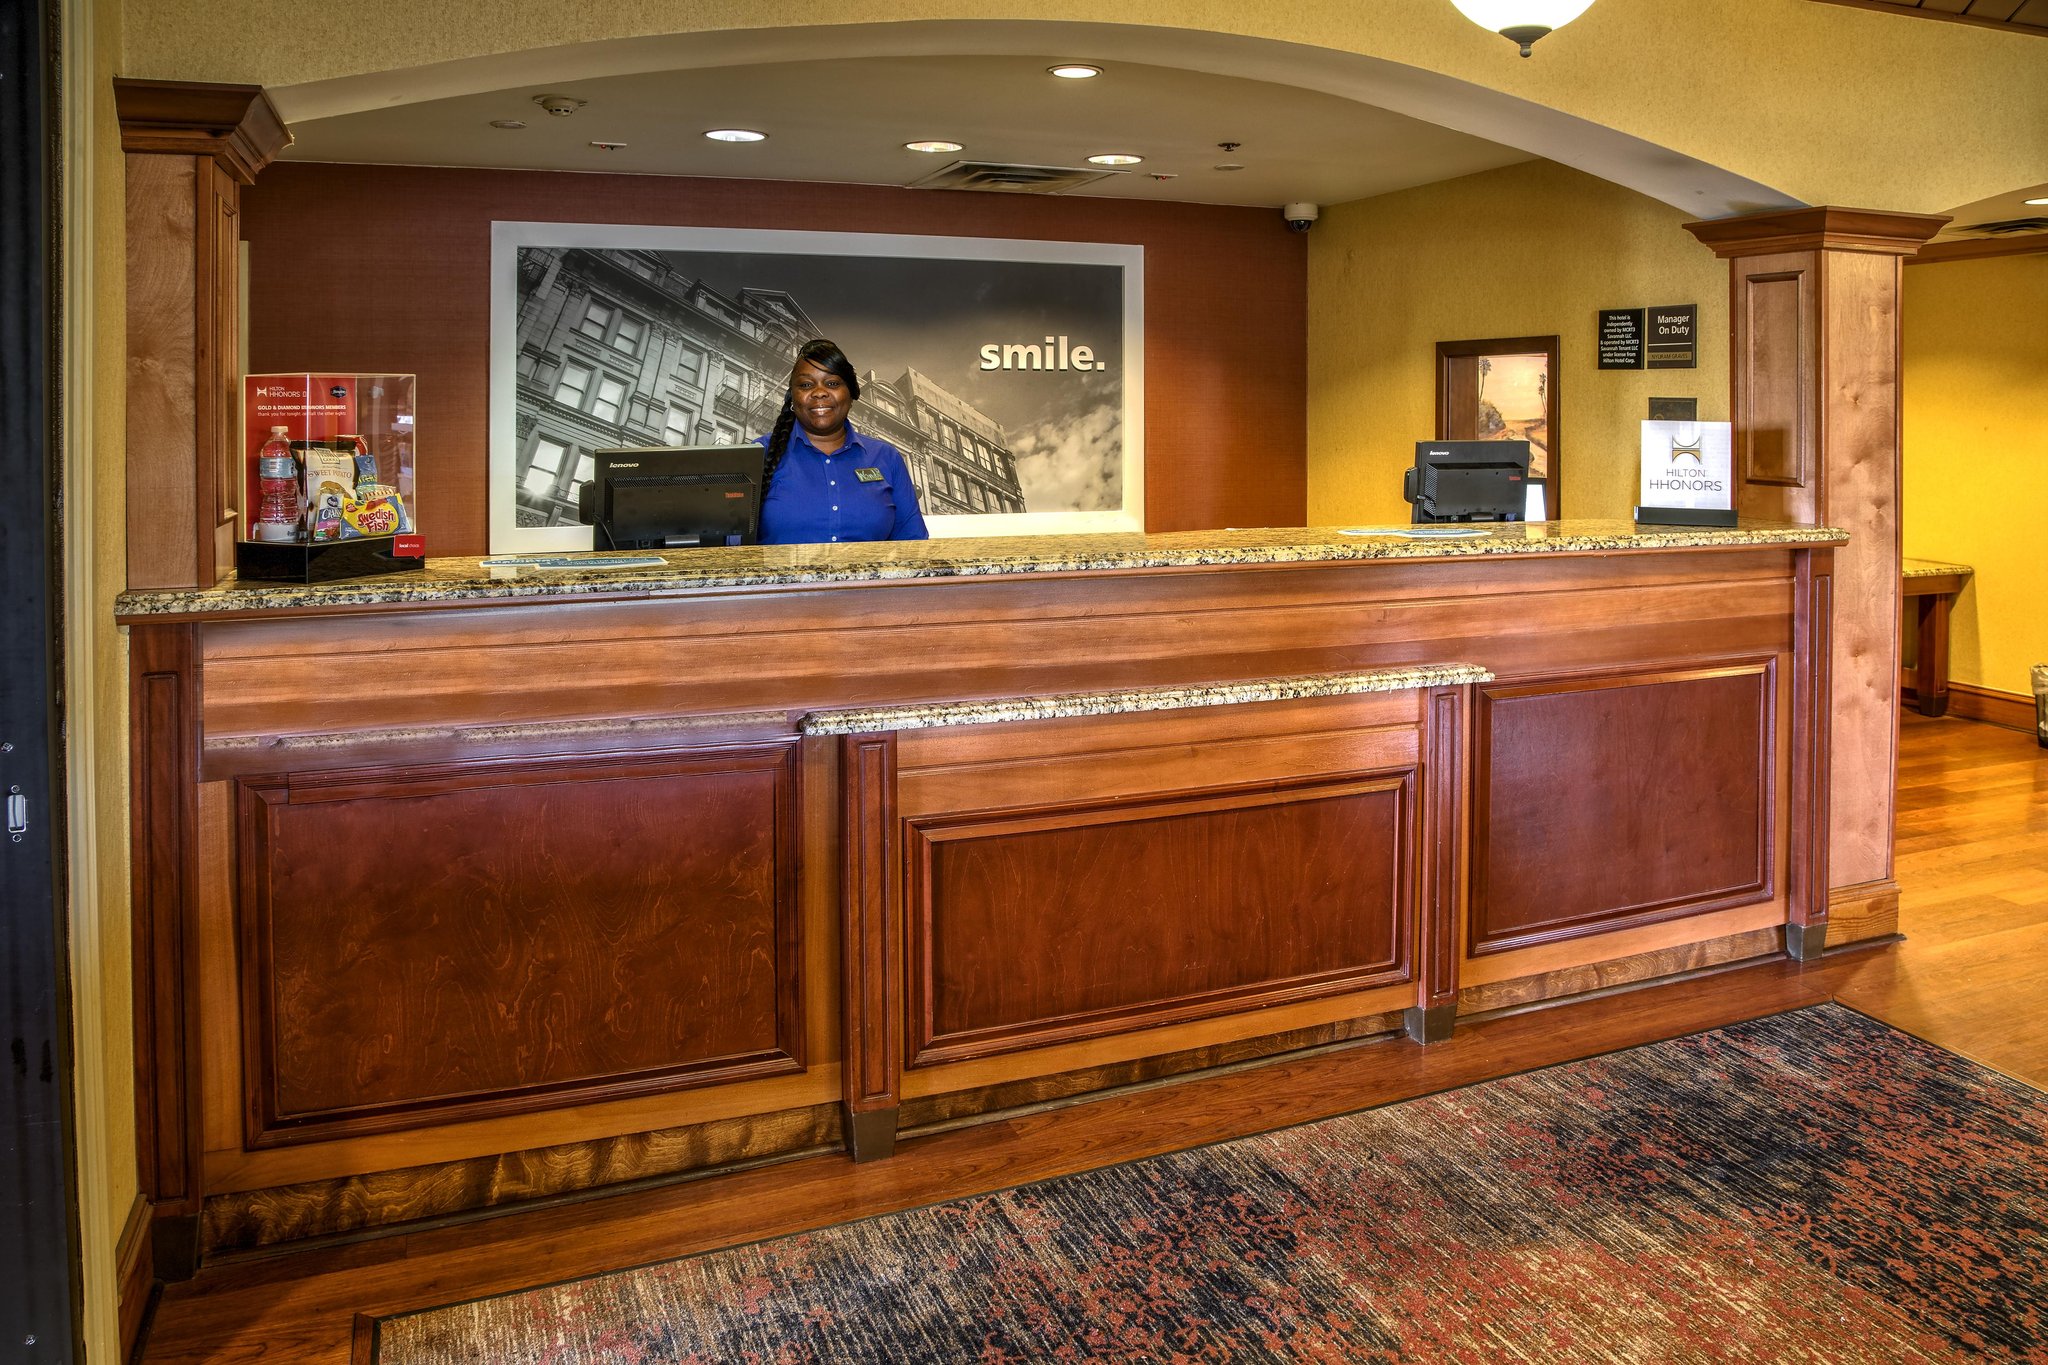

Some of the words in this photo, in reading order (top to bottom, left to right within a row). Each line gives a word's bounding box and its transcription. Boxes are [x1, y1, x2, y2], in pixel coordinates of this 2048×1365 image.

[1658, 315, 1690, 325] Manager
[1671, 326, 1689, 335] Duty
[980, 336, 1105, 372] smile.
[308, 470, 331, 478] SWEET
[332, 470, 352, 478] POTATO
[1666, 469, 1706, 477] HILTON
[1650, 480, 1722, 491] HHONORS
[358, 509, 394, 526] Swedish
[365, 520, 389, 532] Fish
